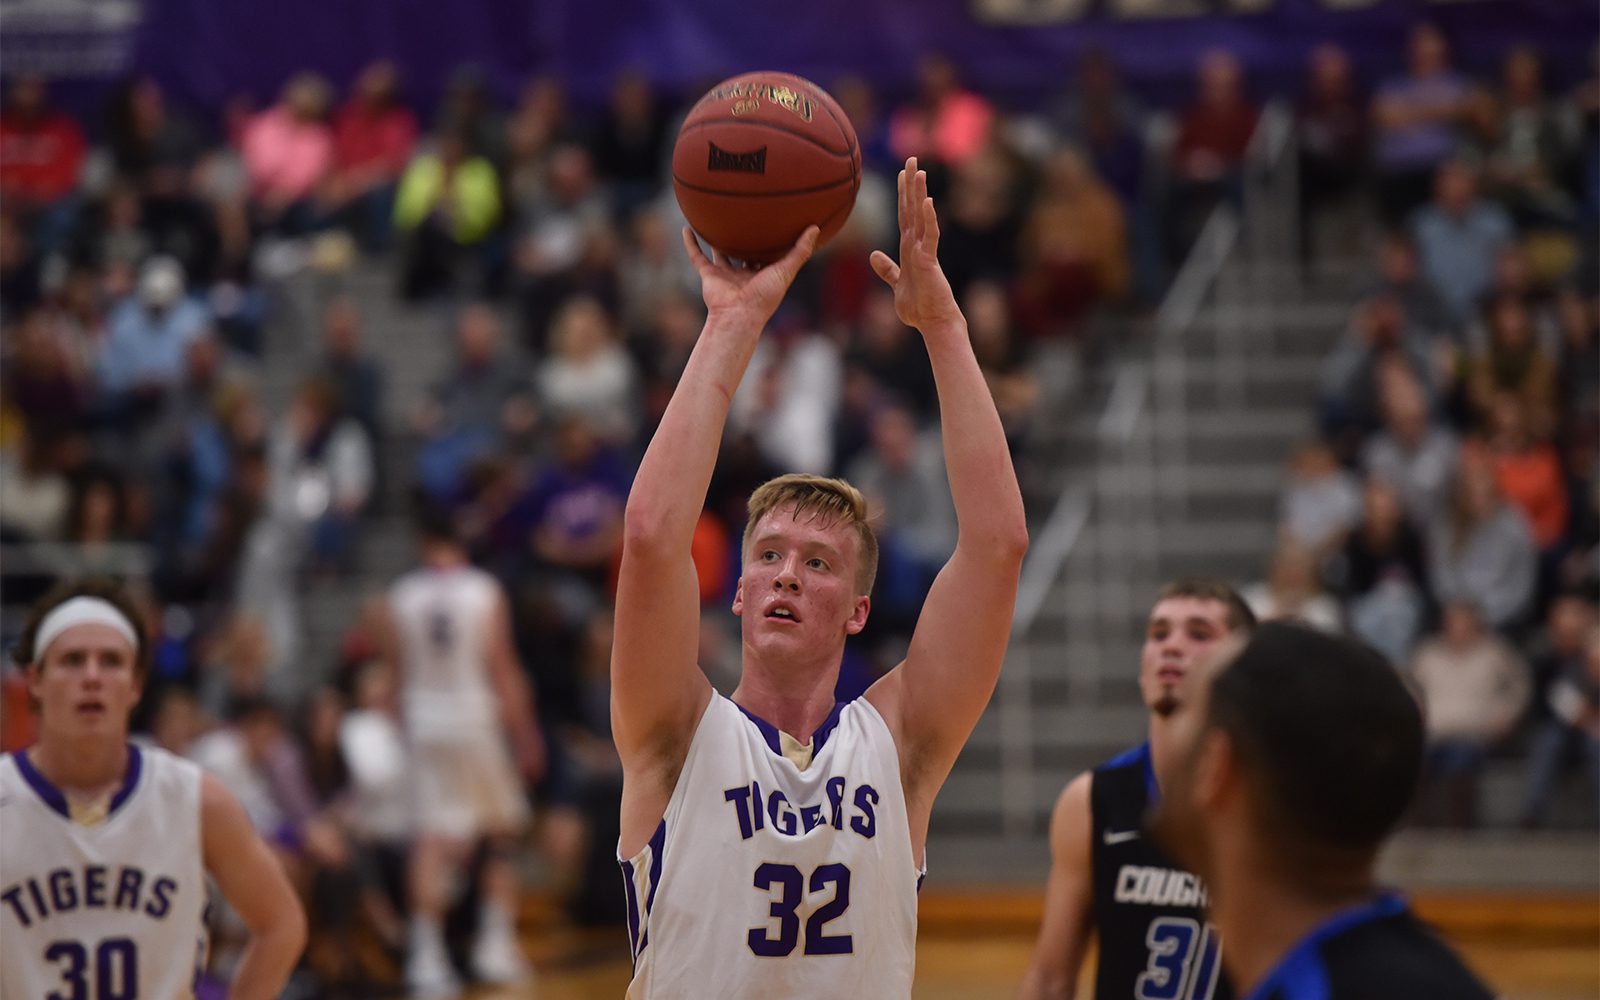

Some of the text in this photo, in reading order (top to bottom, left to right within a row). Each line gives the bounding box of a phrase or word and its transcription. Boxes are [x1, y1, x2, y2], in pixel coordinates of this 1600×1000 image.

[724, 776, 880, 840] TIGERS
[1, 864, 178, 929] TIGERS
[747, 862, 854, 957] 32
[44, 937, 139, 1000] 30
